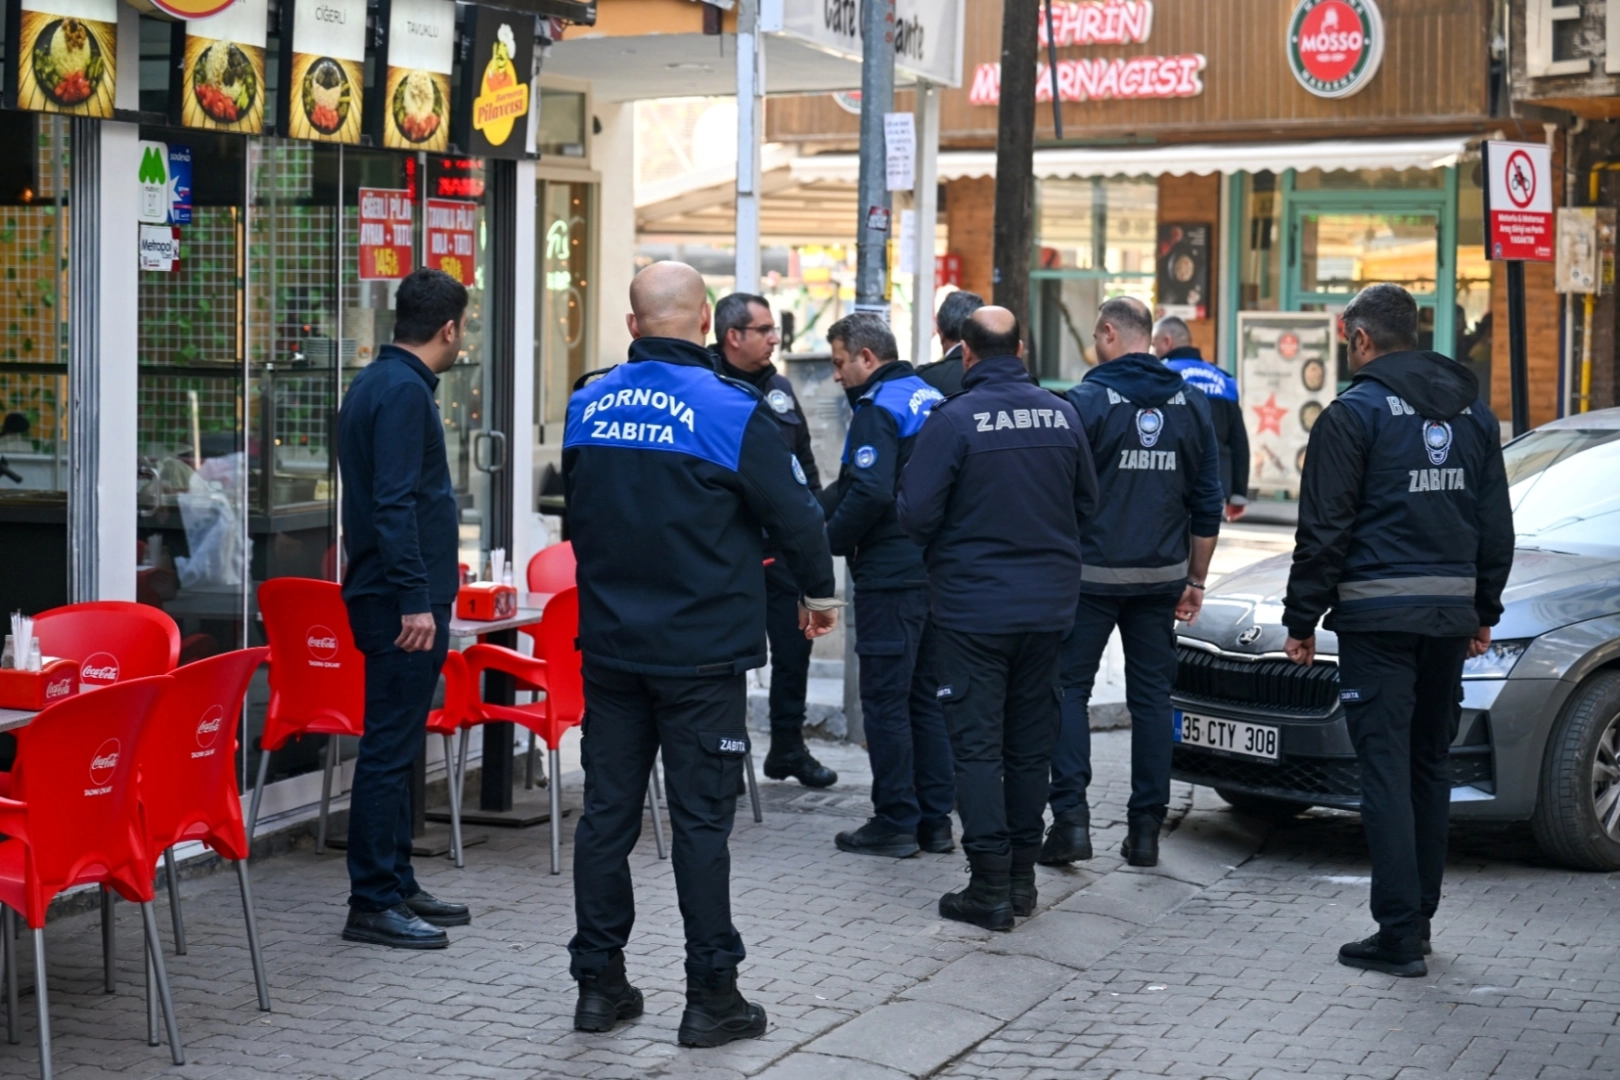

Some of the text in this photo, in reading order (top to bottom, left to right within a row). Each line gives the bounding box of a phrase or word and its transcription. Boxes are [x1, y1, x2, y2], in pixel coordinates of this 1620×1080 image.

[406, 20, 440, 39] TAVUKLU
[1301, 31, 1363, 53] MOSSO
[969, 55, 1202, 105] MARNACISI
[141, 240, 172, 254] Metropol
[582, 388, 695, 433] BORNOVA
[974, 409, 1070, 432] ZABITA
[591, 421, 674, 444] ZABITA
[1118, 449, 1176, 471] ZABITA
[1408, 468, 1465, 492] ZABITA
[468, 598, 476, 613] 1
[82, 665, 118, 680] Coca-Cola
[720, 739, 746, 752] ZABITA
[1182, 715, 1200, 742] 35
[1207, 720, 1236, 749] CTY
[1244, 727, 1276, 756] 308
